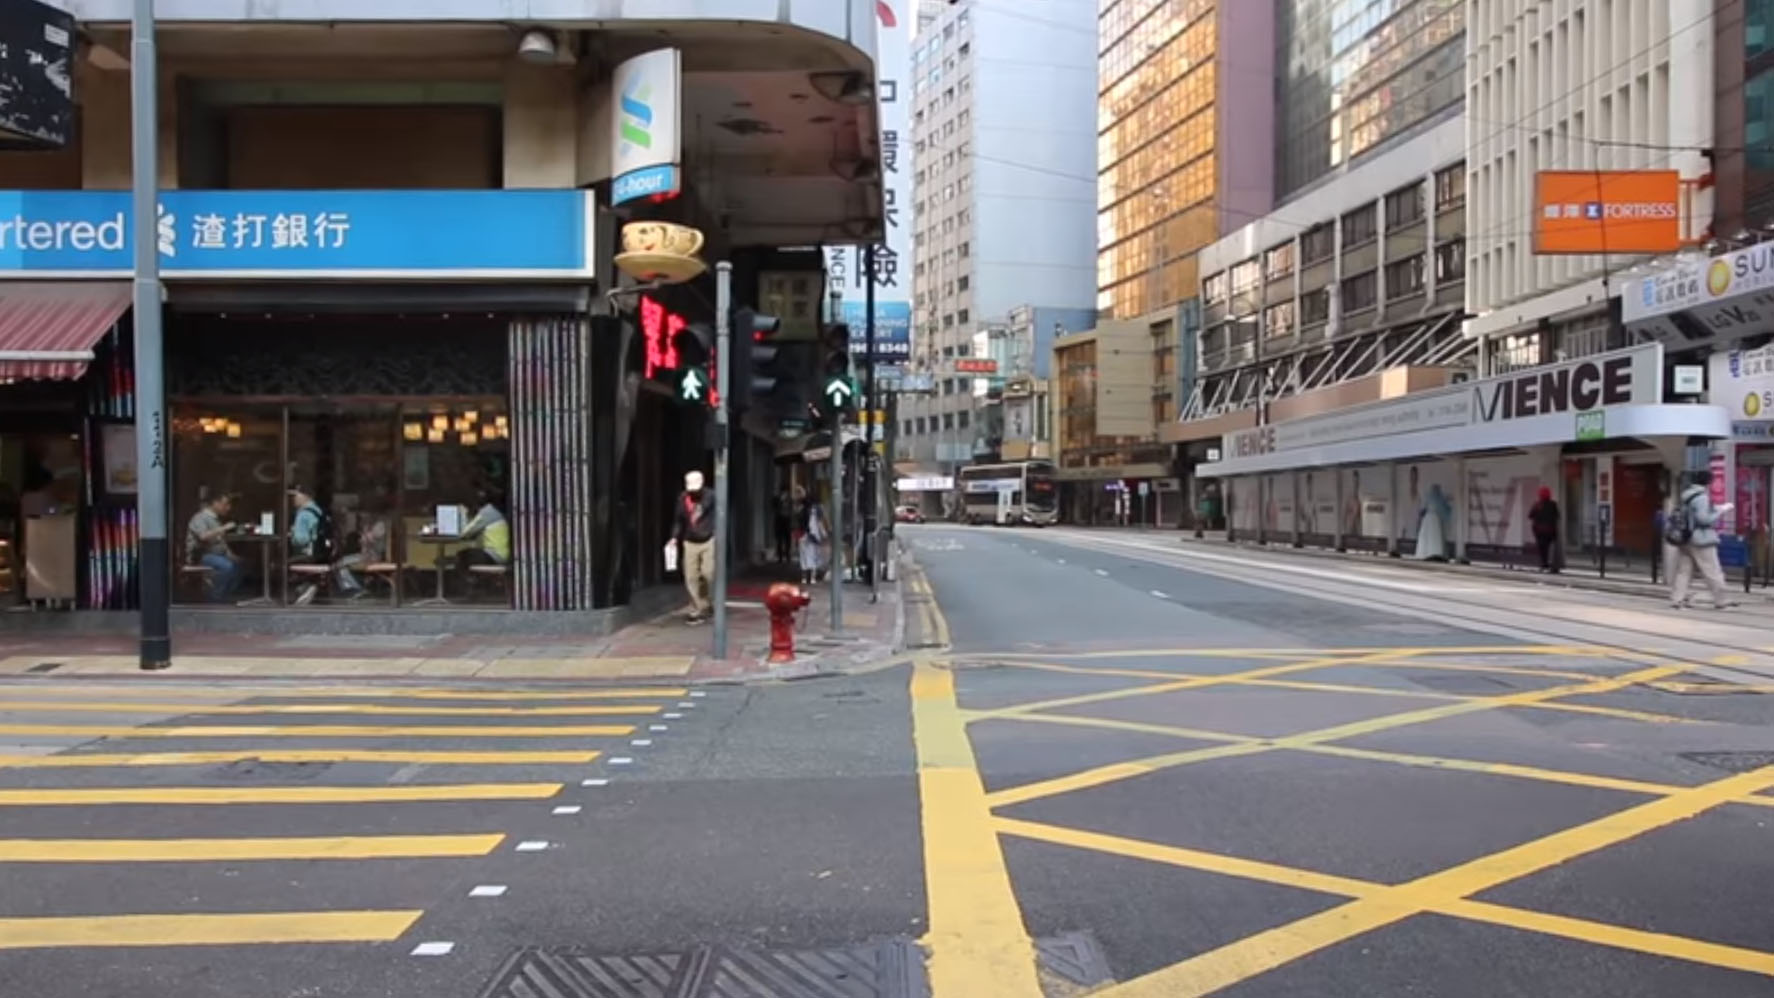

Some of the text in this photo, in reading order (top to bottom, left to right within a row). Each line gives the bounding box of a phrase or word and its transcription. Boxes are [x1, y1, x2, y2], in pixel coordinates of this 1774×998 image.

[1603, 202, 1677, 218] FORTRESS
[192, 212, 350, 249] 渣打銀行
